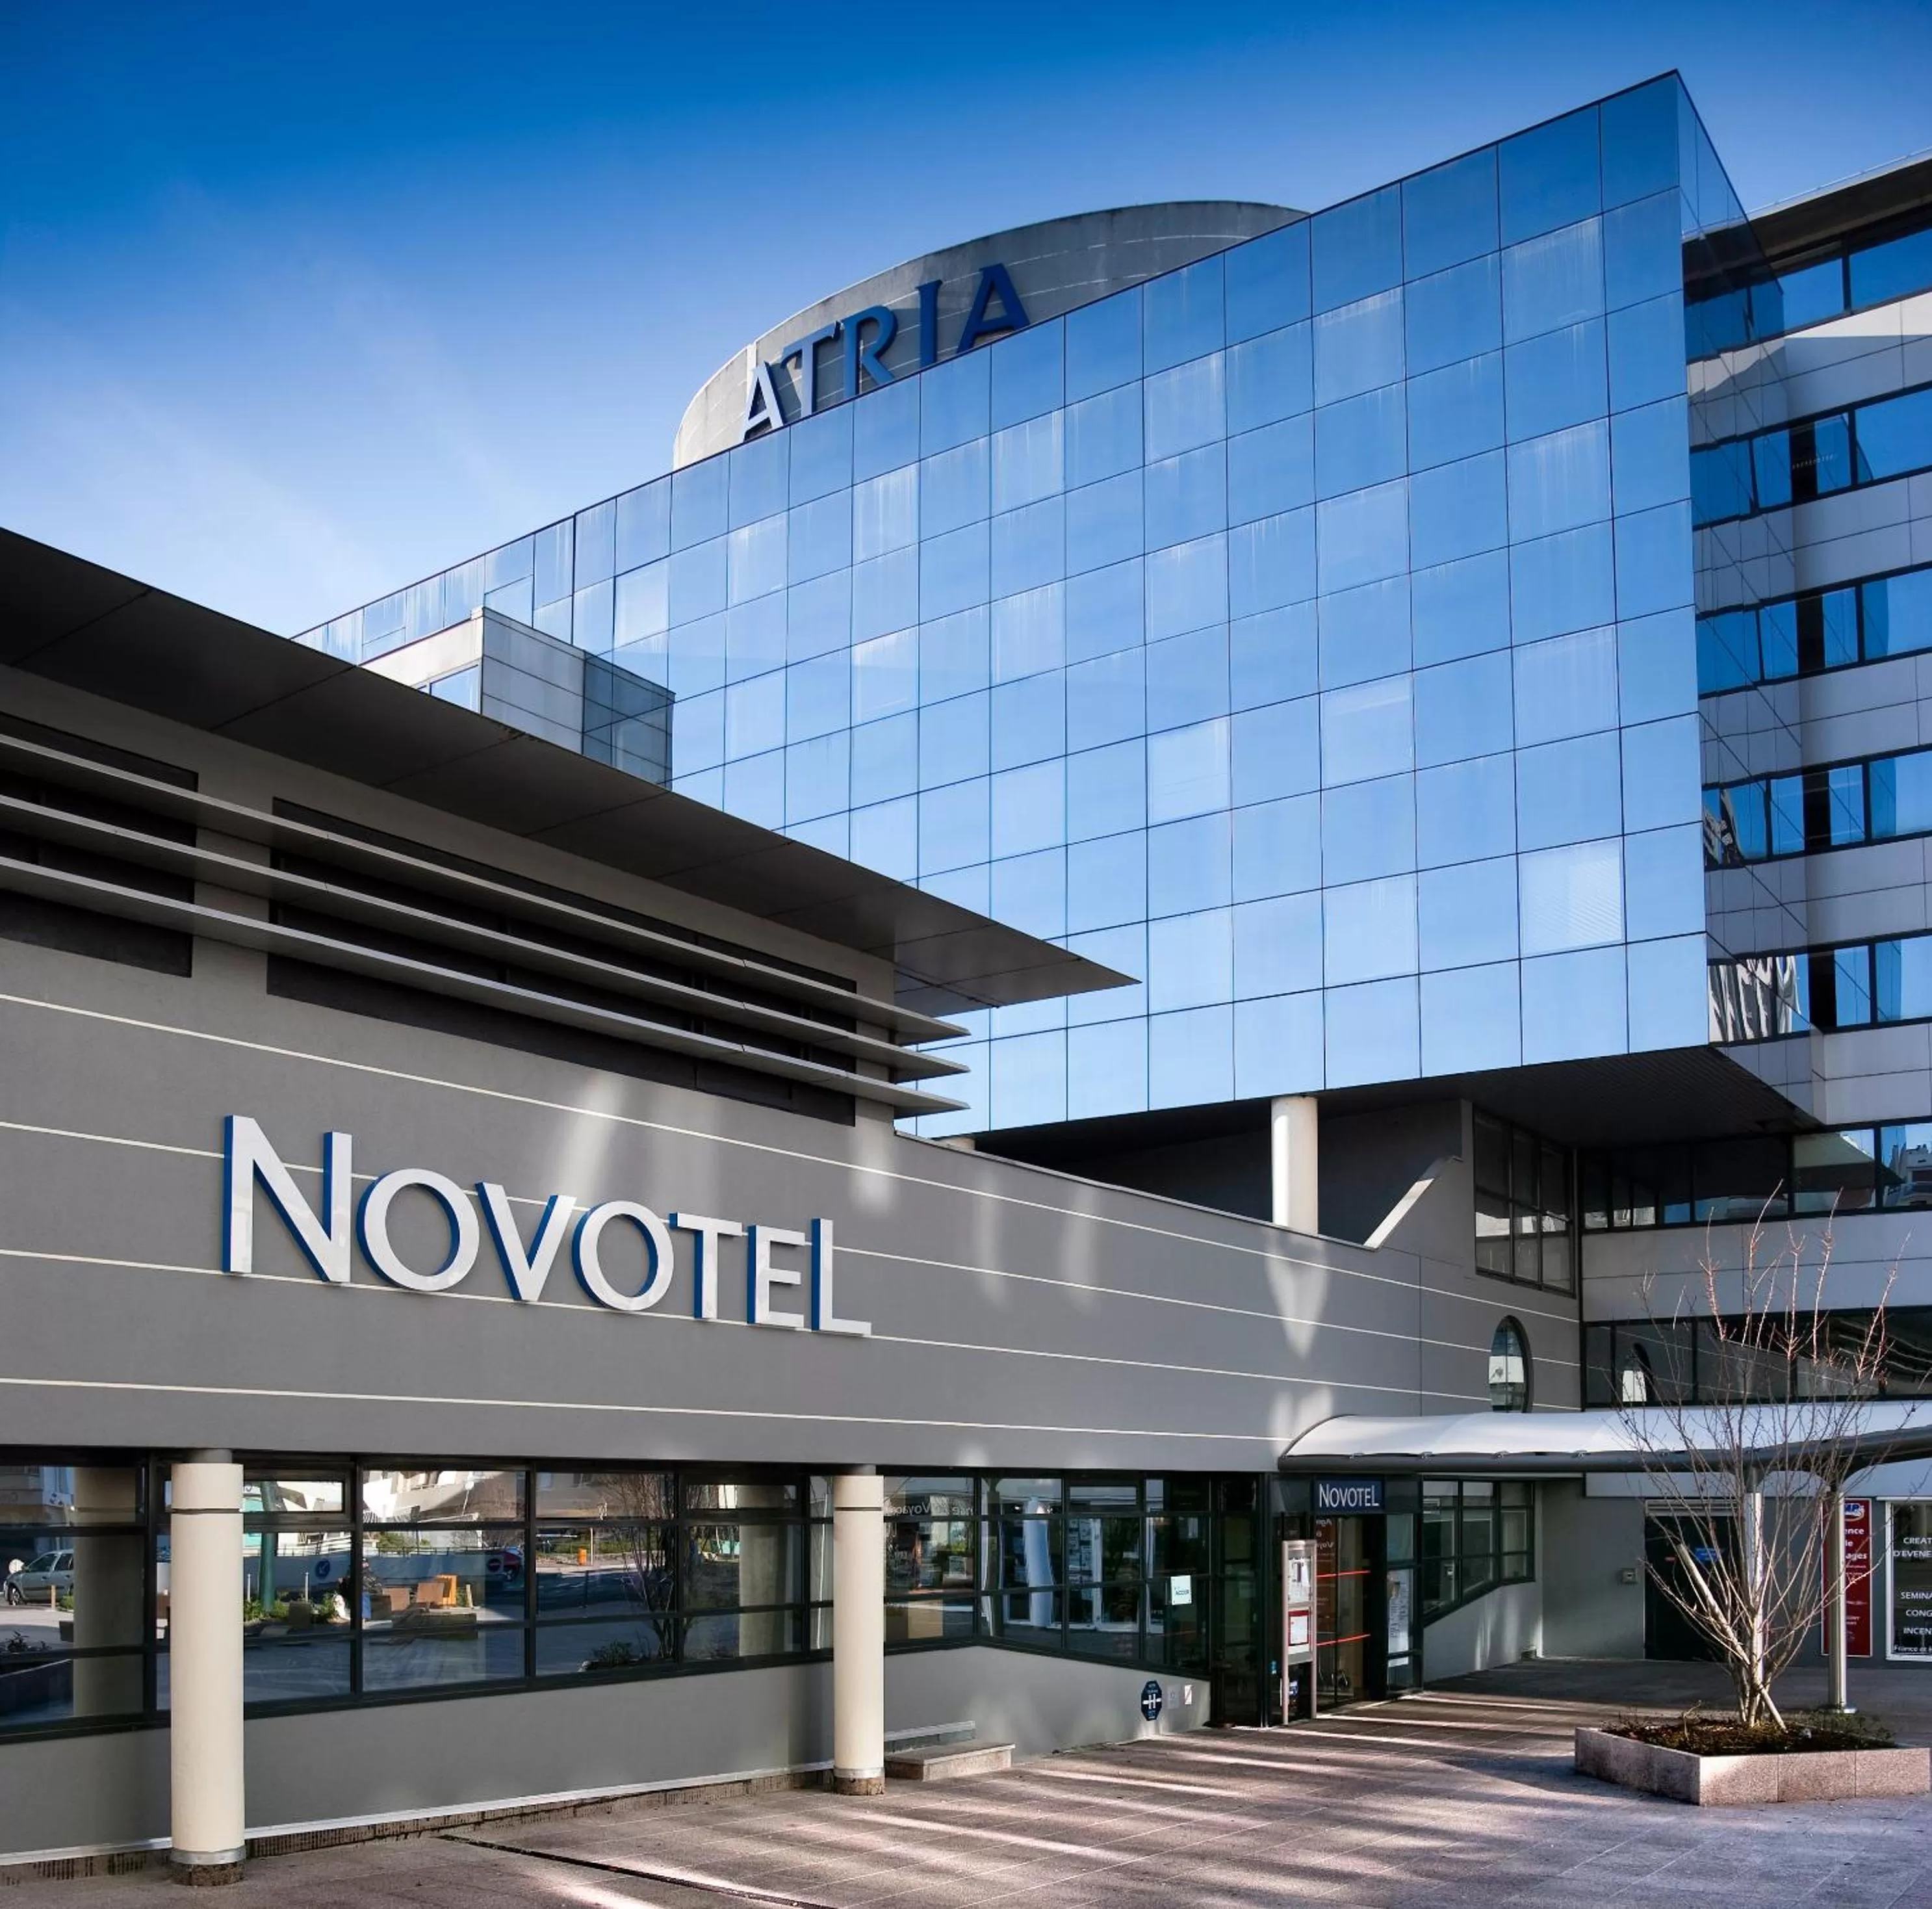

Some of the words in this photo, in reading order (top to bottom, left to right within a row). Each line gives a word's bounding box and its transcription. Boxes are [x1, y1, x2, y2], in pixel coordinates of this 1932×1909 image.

[740, 262, 1031, 443] ATRIA
[222, 1114, 871, 1335] NOVOTEL
[1319, 1483, 1380, 1508] NOVOTEL
